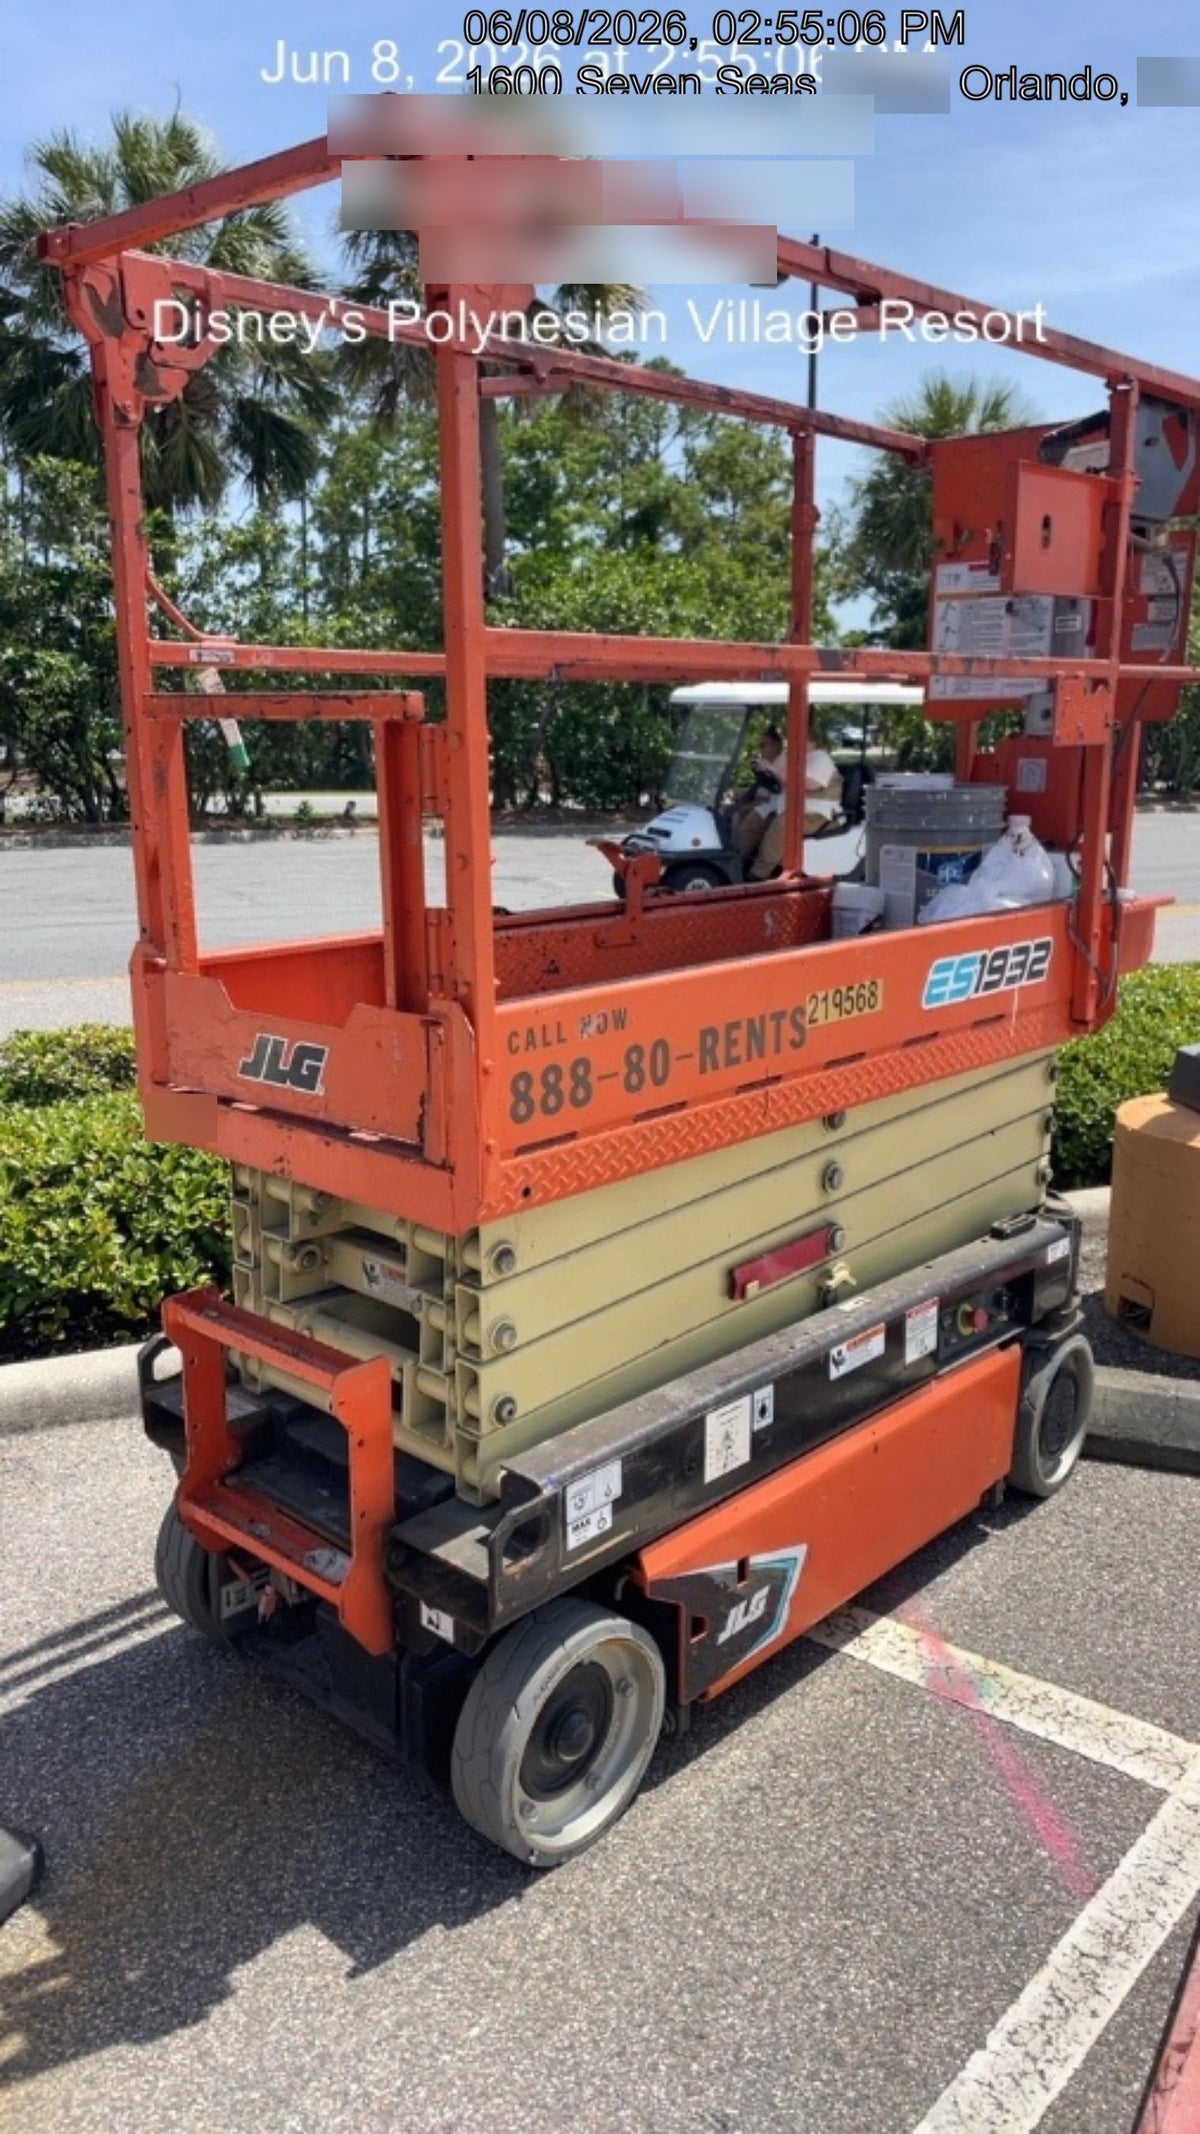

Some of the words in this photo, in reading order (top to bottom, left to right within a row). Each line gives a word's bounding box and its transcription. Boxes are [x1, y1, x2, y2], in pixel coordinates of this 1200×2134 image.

[808, 981, 879, 1025] 219568
[923, 937, 1053, 1009] ES1932
[238, 1033, 330, 1096] JLG
[507, 1021, 568, 1055] CALL
[509, 1005, 807, 1125] 888-80-RENTS
[716, 1584, 771, 1646] JLG
